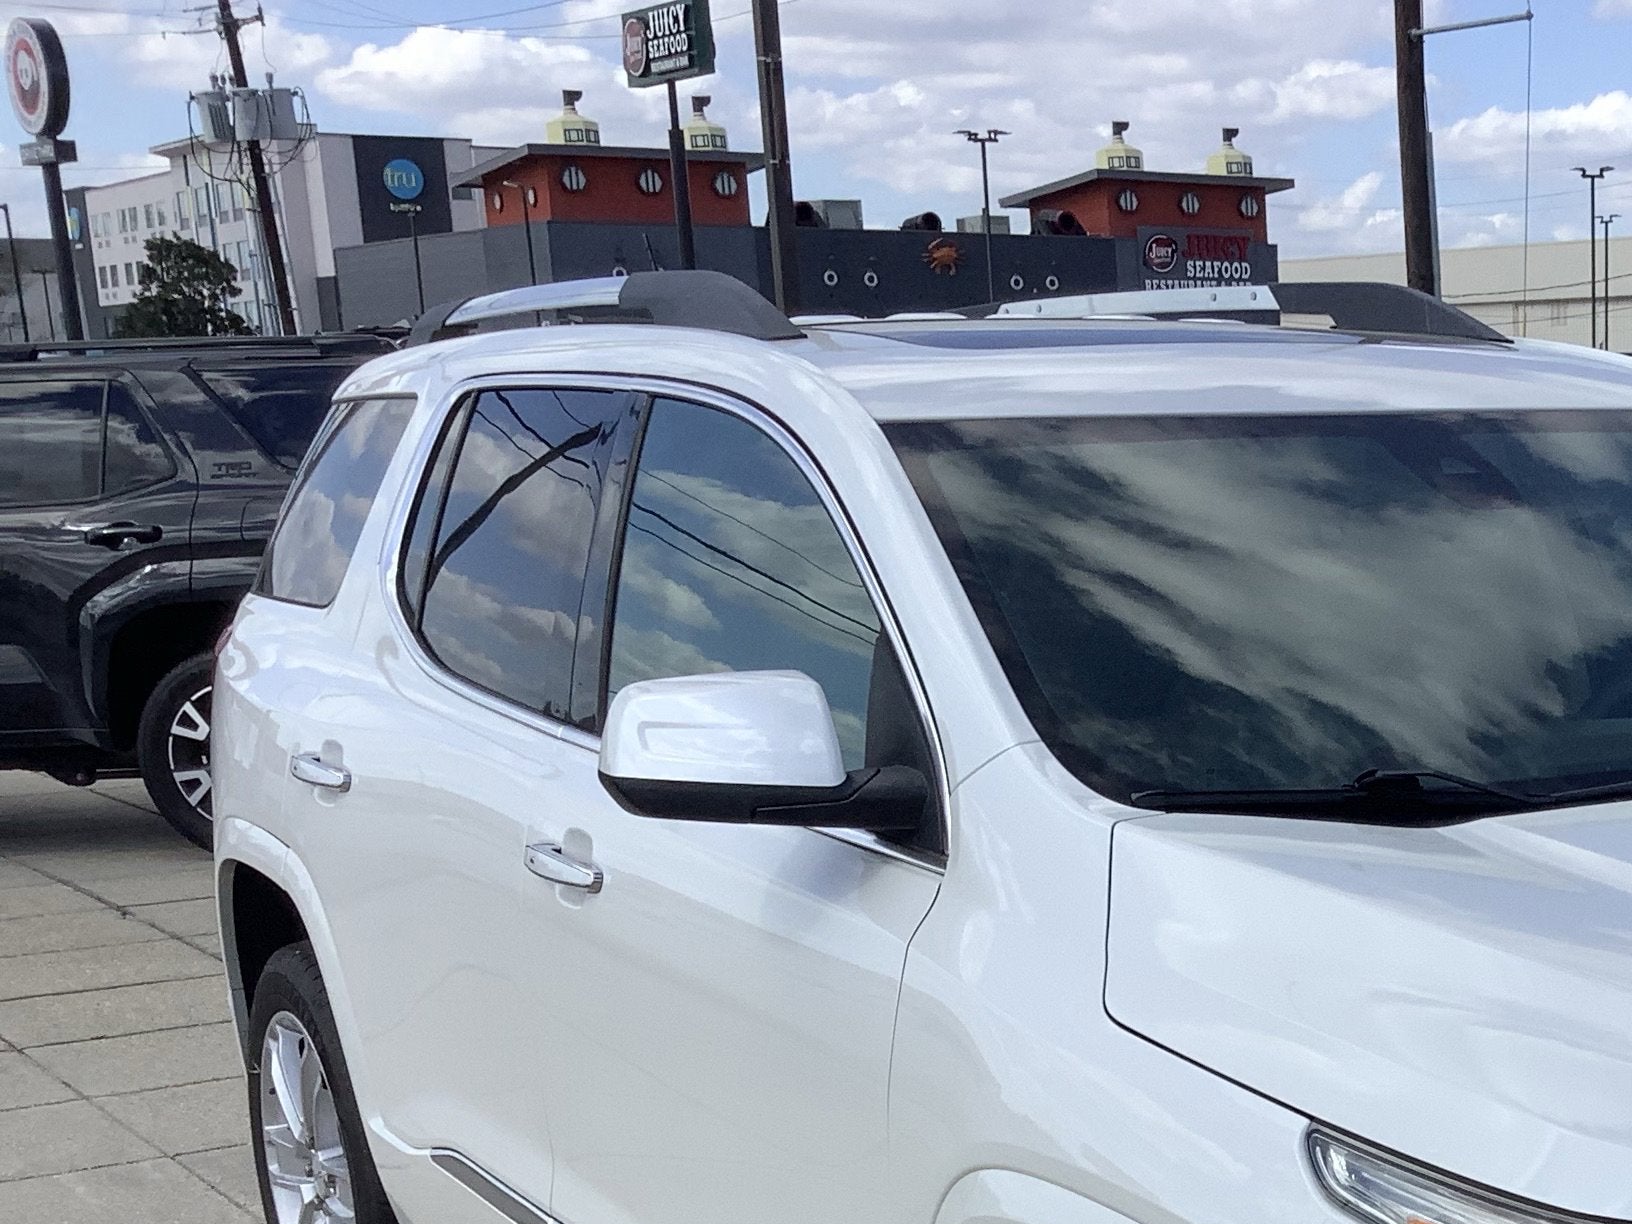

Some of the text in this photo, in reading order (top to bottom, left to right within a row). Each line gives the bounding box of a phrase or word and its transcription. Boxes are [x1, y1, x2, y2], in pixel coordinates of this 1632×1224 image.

[646, 4, 685, 39] JUICY
[648, 33, 688, 59] SEAFOOD
[384, 168, 416, 188] tru
[1182, 233, 1250, 260] JUICY
[1186, 260, 1251, 279] SEAFOOD
[212, 461, 252, 473] TRD
